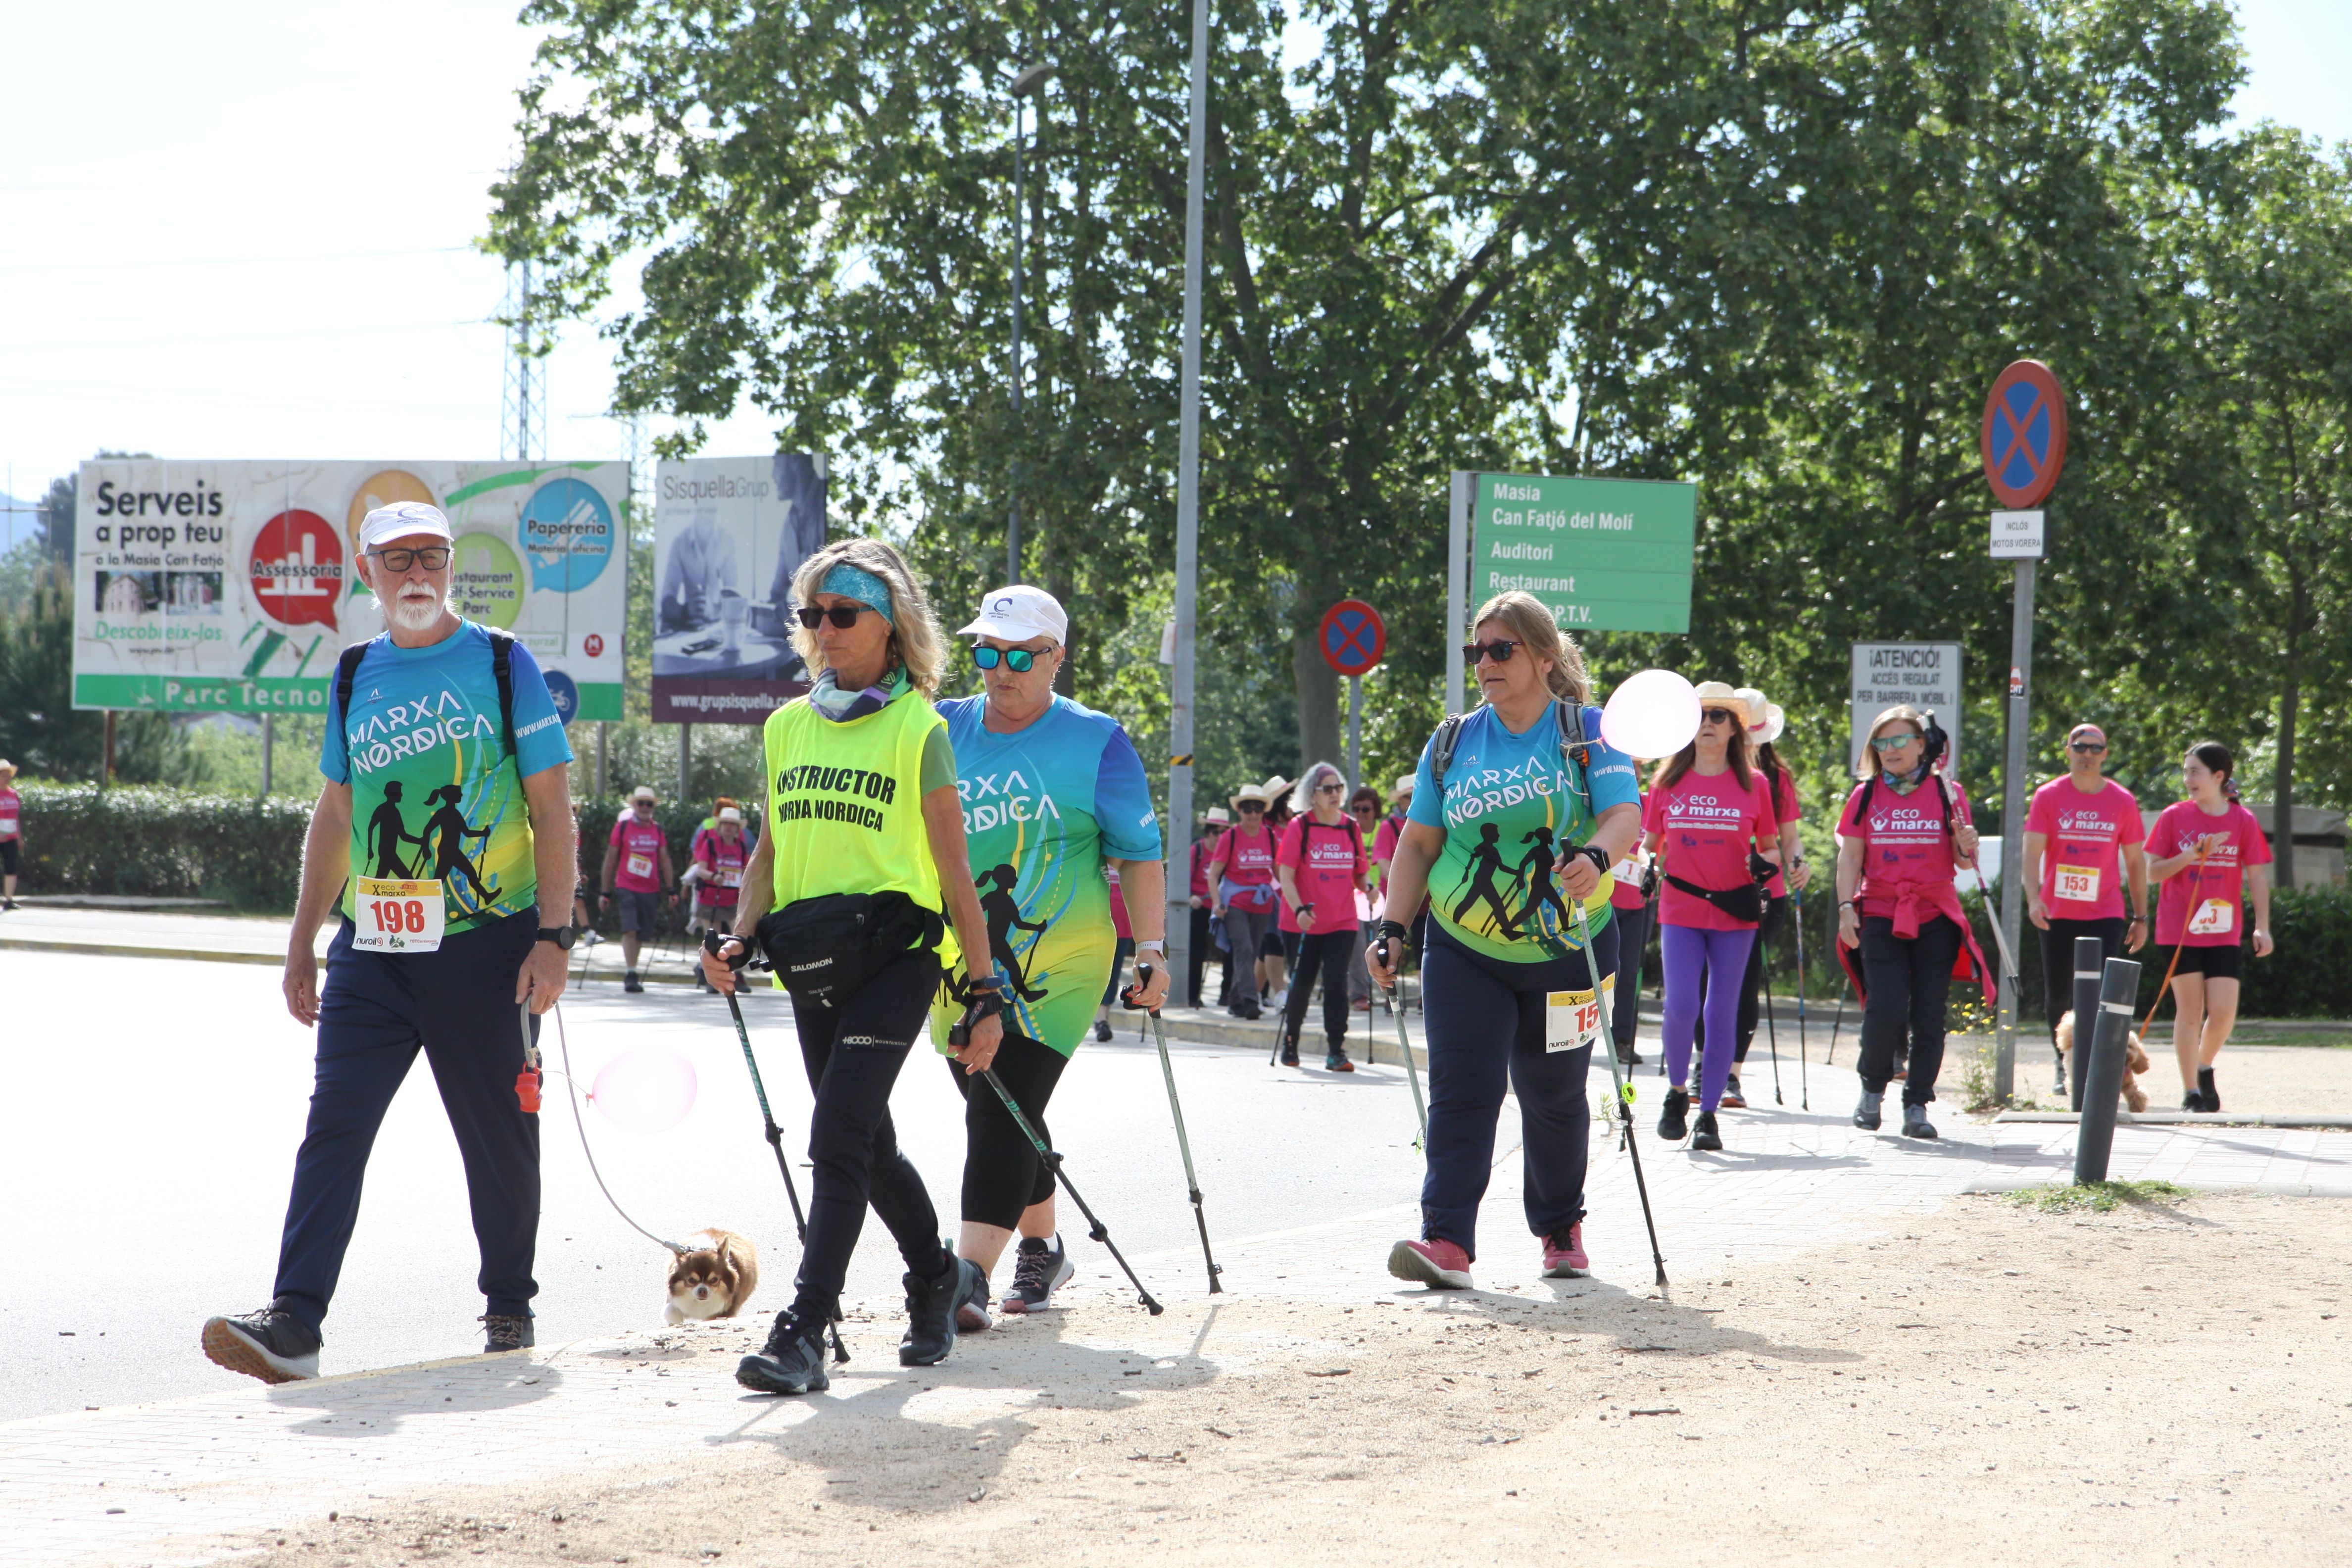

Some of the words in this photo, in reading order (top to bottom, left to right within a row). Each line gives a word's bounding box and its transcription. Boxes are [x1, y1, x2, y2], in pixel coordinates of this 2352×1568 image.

[97, 480, 223, 516] Serveis
[1493, 484, 1540, 502] Masia
[1492, 508, 1522, 526] Can
[1527, 510, 1566, 532] Fatjó
[1570, 512, 1594, 530] del
[1599, 512, 1633, 531] Molí
[2005, 520, 2028, 531] INCLÓS
[97, 526, 110, 542] a
[121, 526, 176, 550] prop
[186, 522, 223, 542] teu
[528, 519, 606, 538] Papereria
[1491, 541, 1553, 561] Auditori
[1992, 539, 2013, 548] MOTOS
[2015, 539, 2040, 547] VORERA
[96, 557, 103, 565] a
[108, 553, 119, 565] la
[125, 553, 161, 565] Masia
[166, 553, 189, 565] Can
[253, 561, 343, 577] Assessoria
[1489, 572, 1575, 592] Restaurant
[463, 601, 491, 614] Parc
[1902, 673, 1941, 686] REGULAT
[165, 681, 227, 705] Parc
[1857, 689, 1873, 703] PER
[1876, 690, 1916, 704] BARRERA
[350, 690, 462, 750] MARXA
[777, 765, 896, 805] INSTRUCTOR
[958, 770, 1029, 802] RXA
[1447, 755, 1546, 805] MARXA
[1689, 794, 1717, 806] eco
[814, 799, 883, 833] NORDICA
[963, 794, 1060, 834] RDICA
[1688, 806, 1741, 818] marxa
[1892, 808, 1920, 819] eco
[2076, 810, 2099, 820] eco
[1891, 820, 1941, 830] marxa
[2075, 820, 2115, 832] marxa
[372, 884, 381, 896] X
[2063, 875, 2089, 892] 153
[370, 900, 425, 934] 198
[356, 937, 377, 946] nuroil
[791, 957, 833, 973] SALOMON
[1568, 995, 1578, 1006] X
[1548, 1039, 1569, 1048] nuroil
